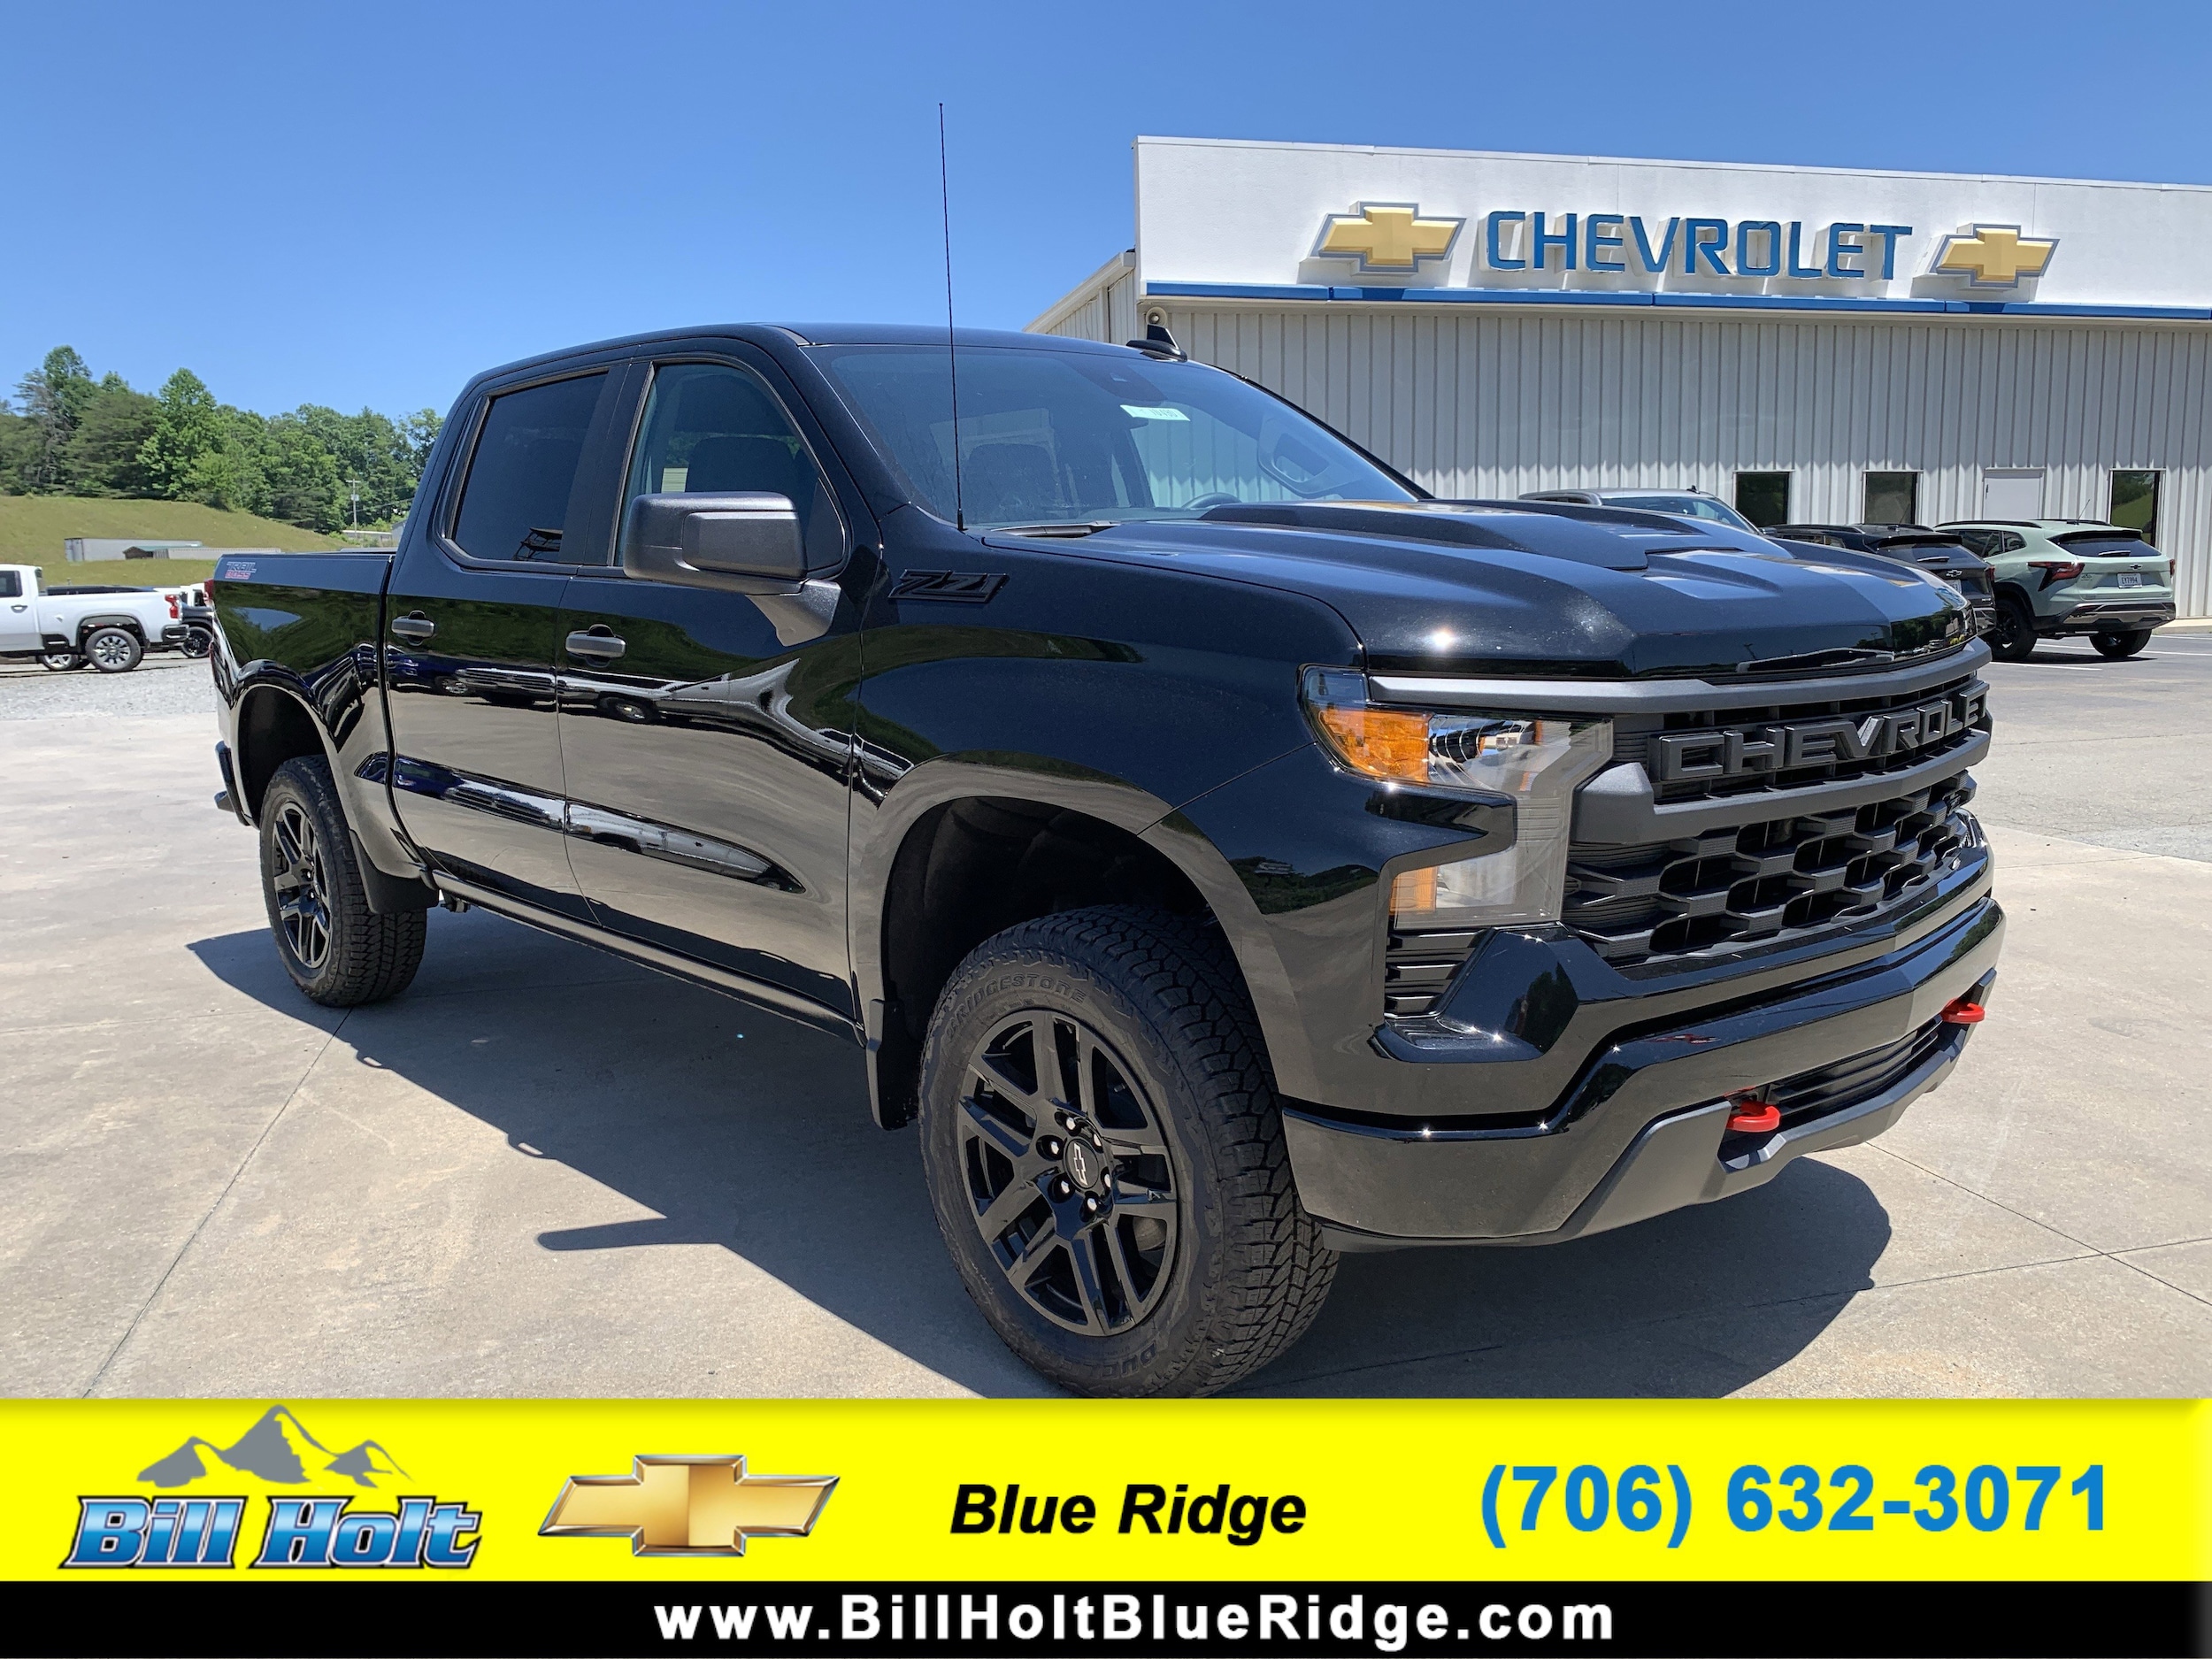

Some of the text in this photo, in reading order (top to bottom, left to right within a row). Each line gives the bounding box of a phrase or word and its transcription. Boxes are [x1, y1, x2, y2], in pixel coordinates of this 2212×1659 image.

[1486, 211, 1912, 280] CHEVROLET
[225, 570, 251, 580] BOSS
[226, 561, 257, 572] TRAIL
[888, 569, 1010, 603] Z71
[1660, 684, 1987, 780] CHEVROLET
[945, 973, 1087, 1039] BRIDGESTONE
